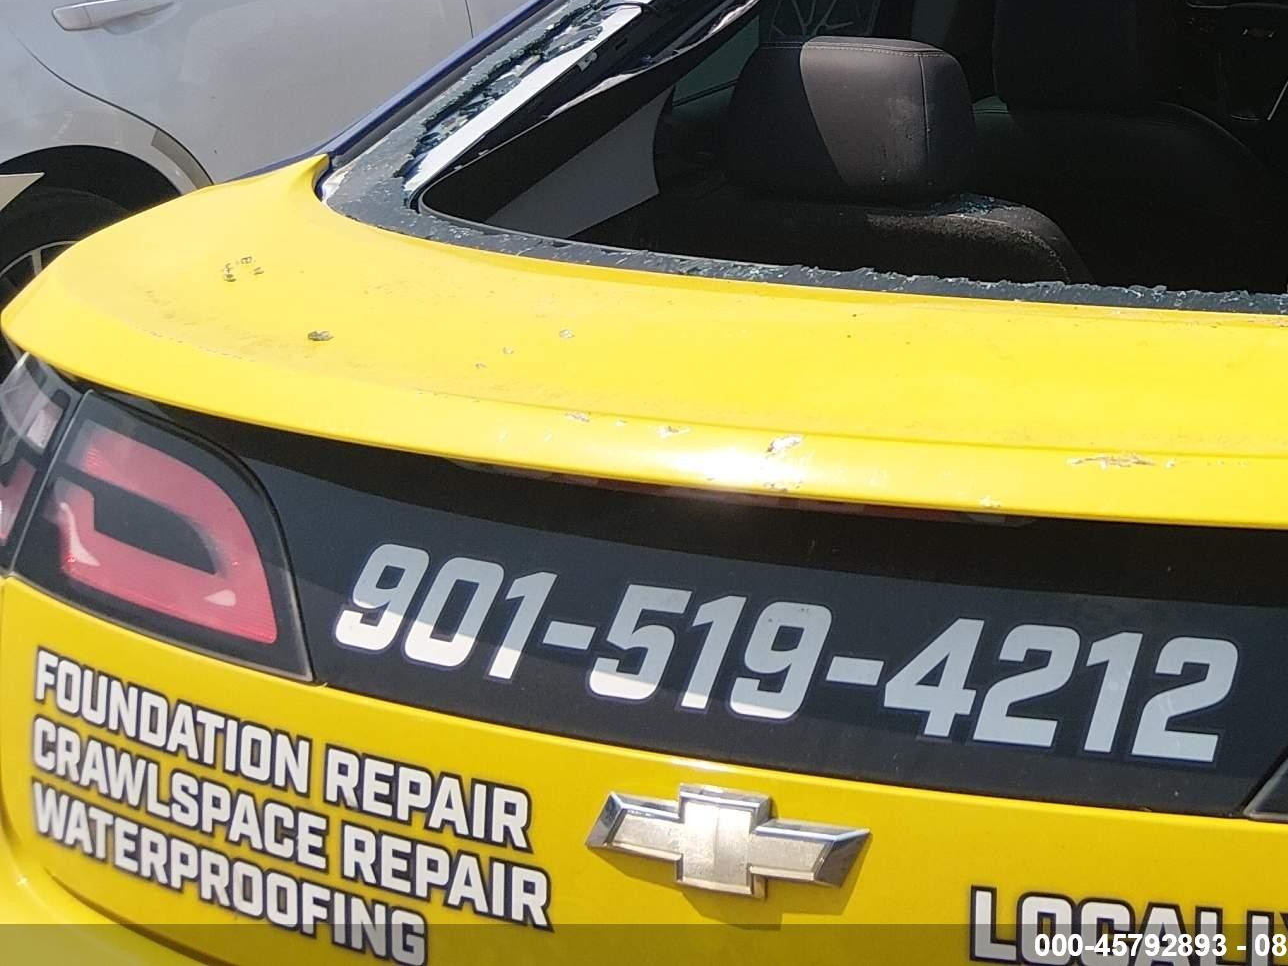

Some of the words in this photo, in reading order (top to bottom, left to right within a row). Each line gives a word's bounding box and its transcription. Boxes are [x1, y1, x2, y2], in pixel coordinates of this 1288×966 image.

[34, 647, 311, 795] FOUNDATION
[324, 746, 529, 850] REPAIR
[334, 542, 1239, 763] 901-519-4212
[32, 780, 427, 966] WATERPROOFING
[33, 716, 328, 870] CRAWLSPACE
[342, 823, 549, 928] REPAIR
